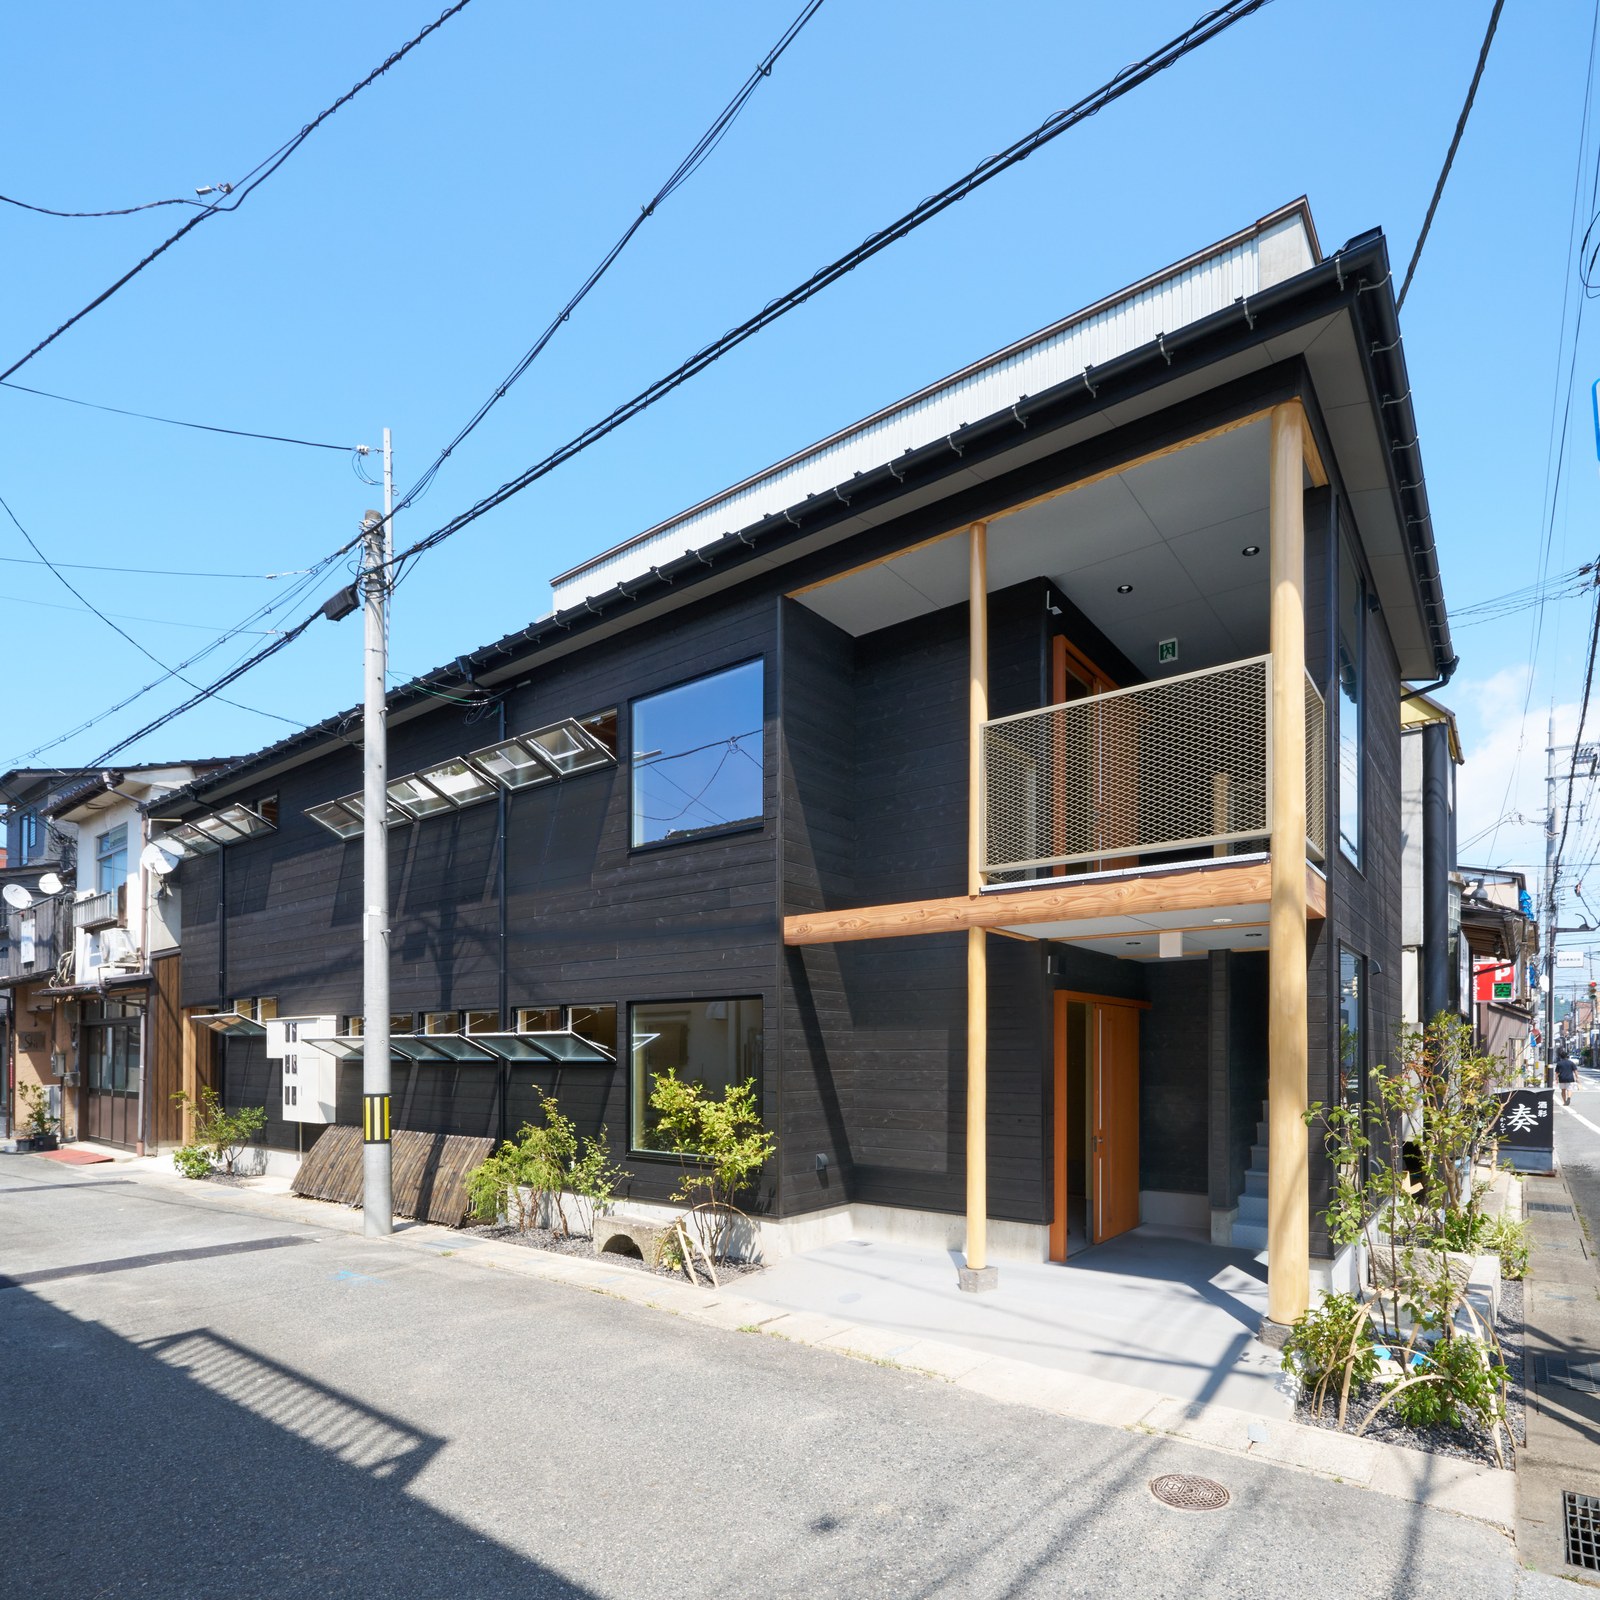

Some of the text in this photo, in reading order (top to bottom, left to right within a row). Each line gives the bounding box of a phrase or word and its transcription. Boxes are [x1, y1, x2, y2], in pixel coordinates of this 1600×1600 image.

[1495, 964, 1510, 981] P
[1494, 983, 1511, 998] 空
[1507, 1103, 1539, 1132] 奏
